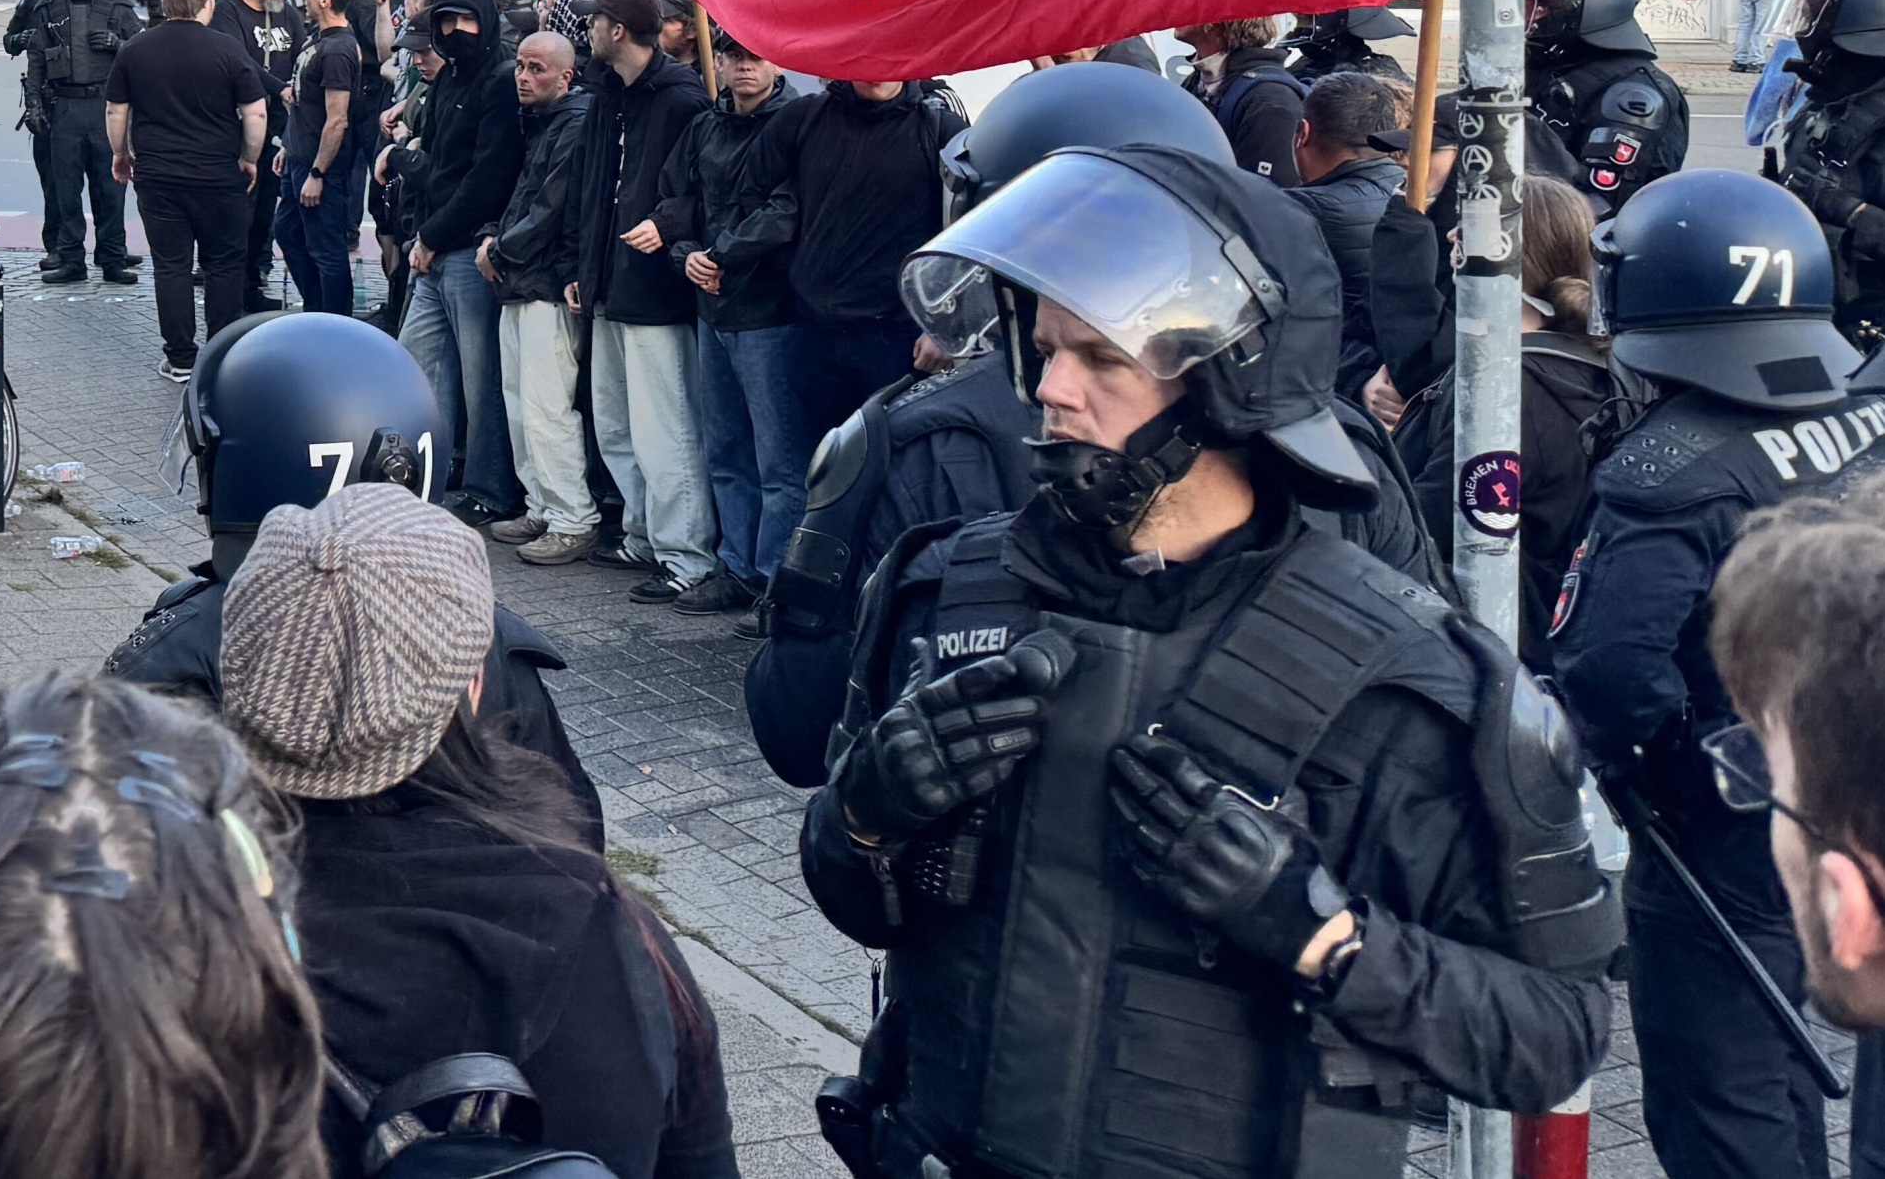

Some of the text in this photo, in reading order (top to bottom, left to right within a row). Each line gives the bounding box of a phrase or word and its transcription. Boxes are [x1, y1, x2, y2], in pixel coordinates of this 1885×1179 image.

[1728, 245, 1793, 308] 71
[1465, 459, 1499, 506] BREMEN
[937, 626, 1008, 659] POLIZEI
